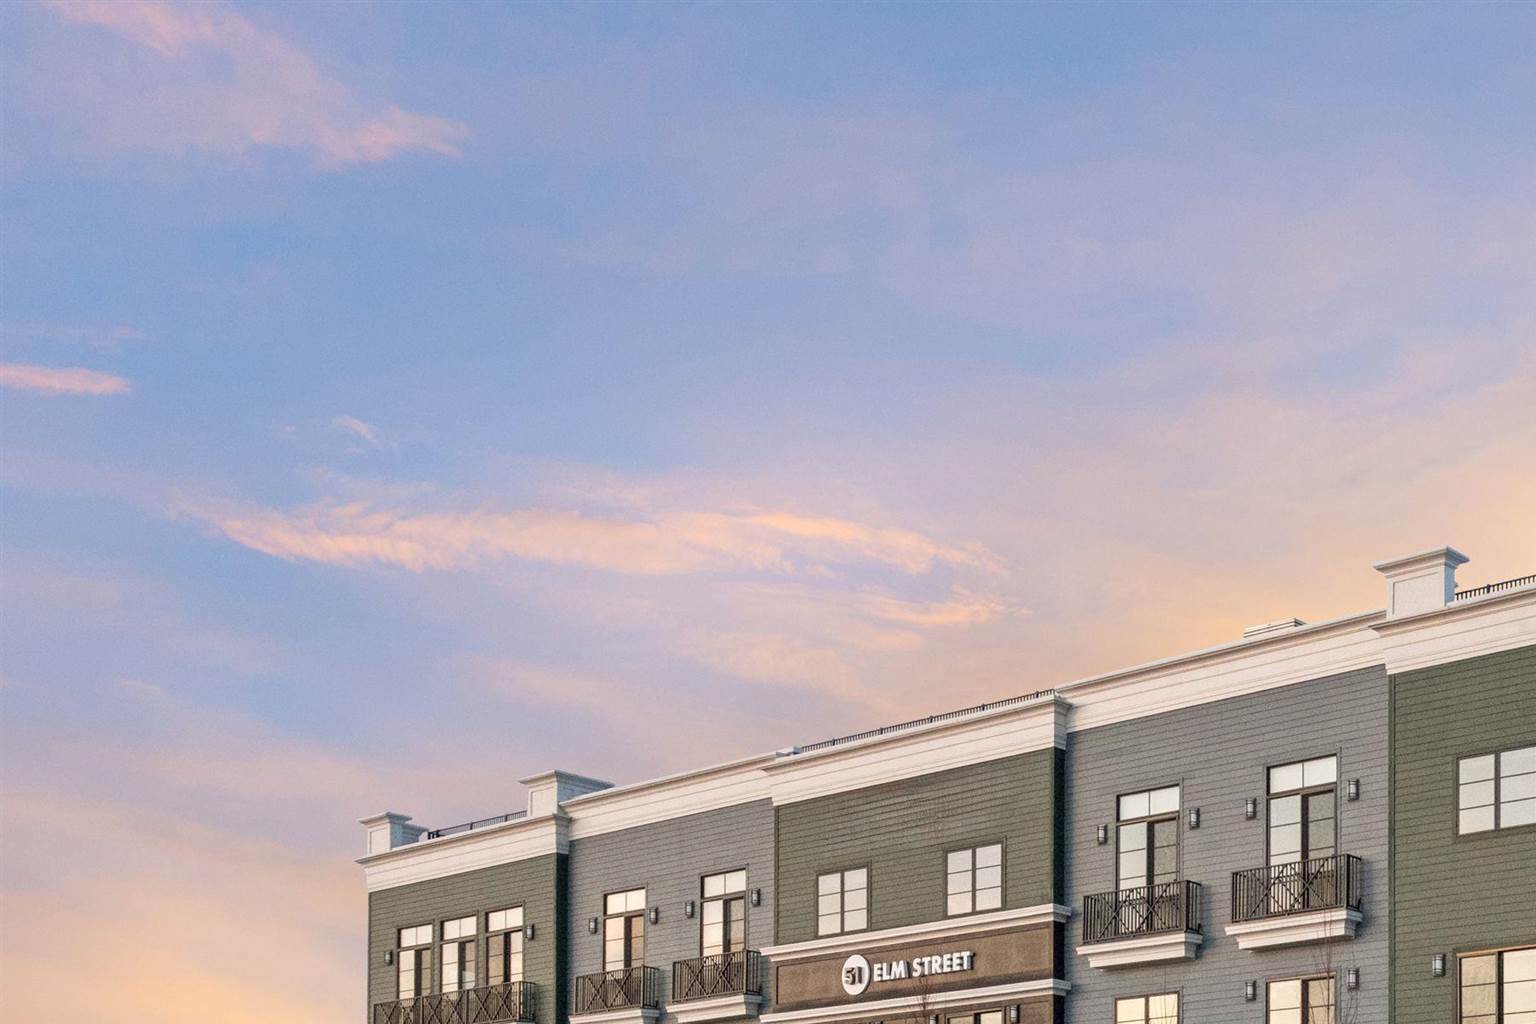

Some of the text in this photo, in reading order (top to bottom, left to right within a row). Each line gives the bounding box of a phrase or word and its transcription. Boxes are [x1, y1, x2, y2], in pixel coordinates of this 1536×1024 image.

[845, 950, 974, 985] 51 ELM STREET
